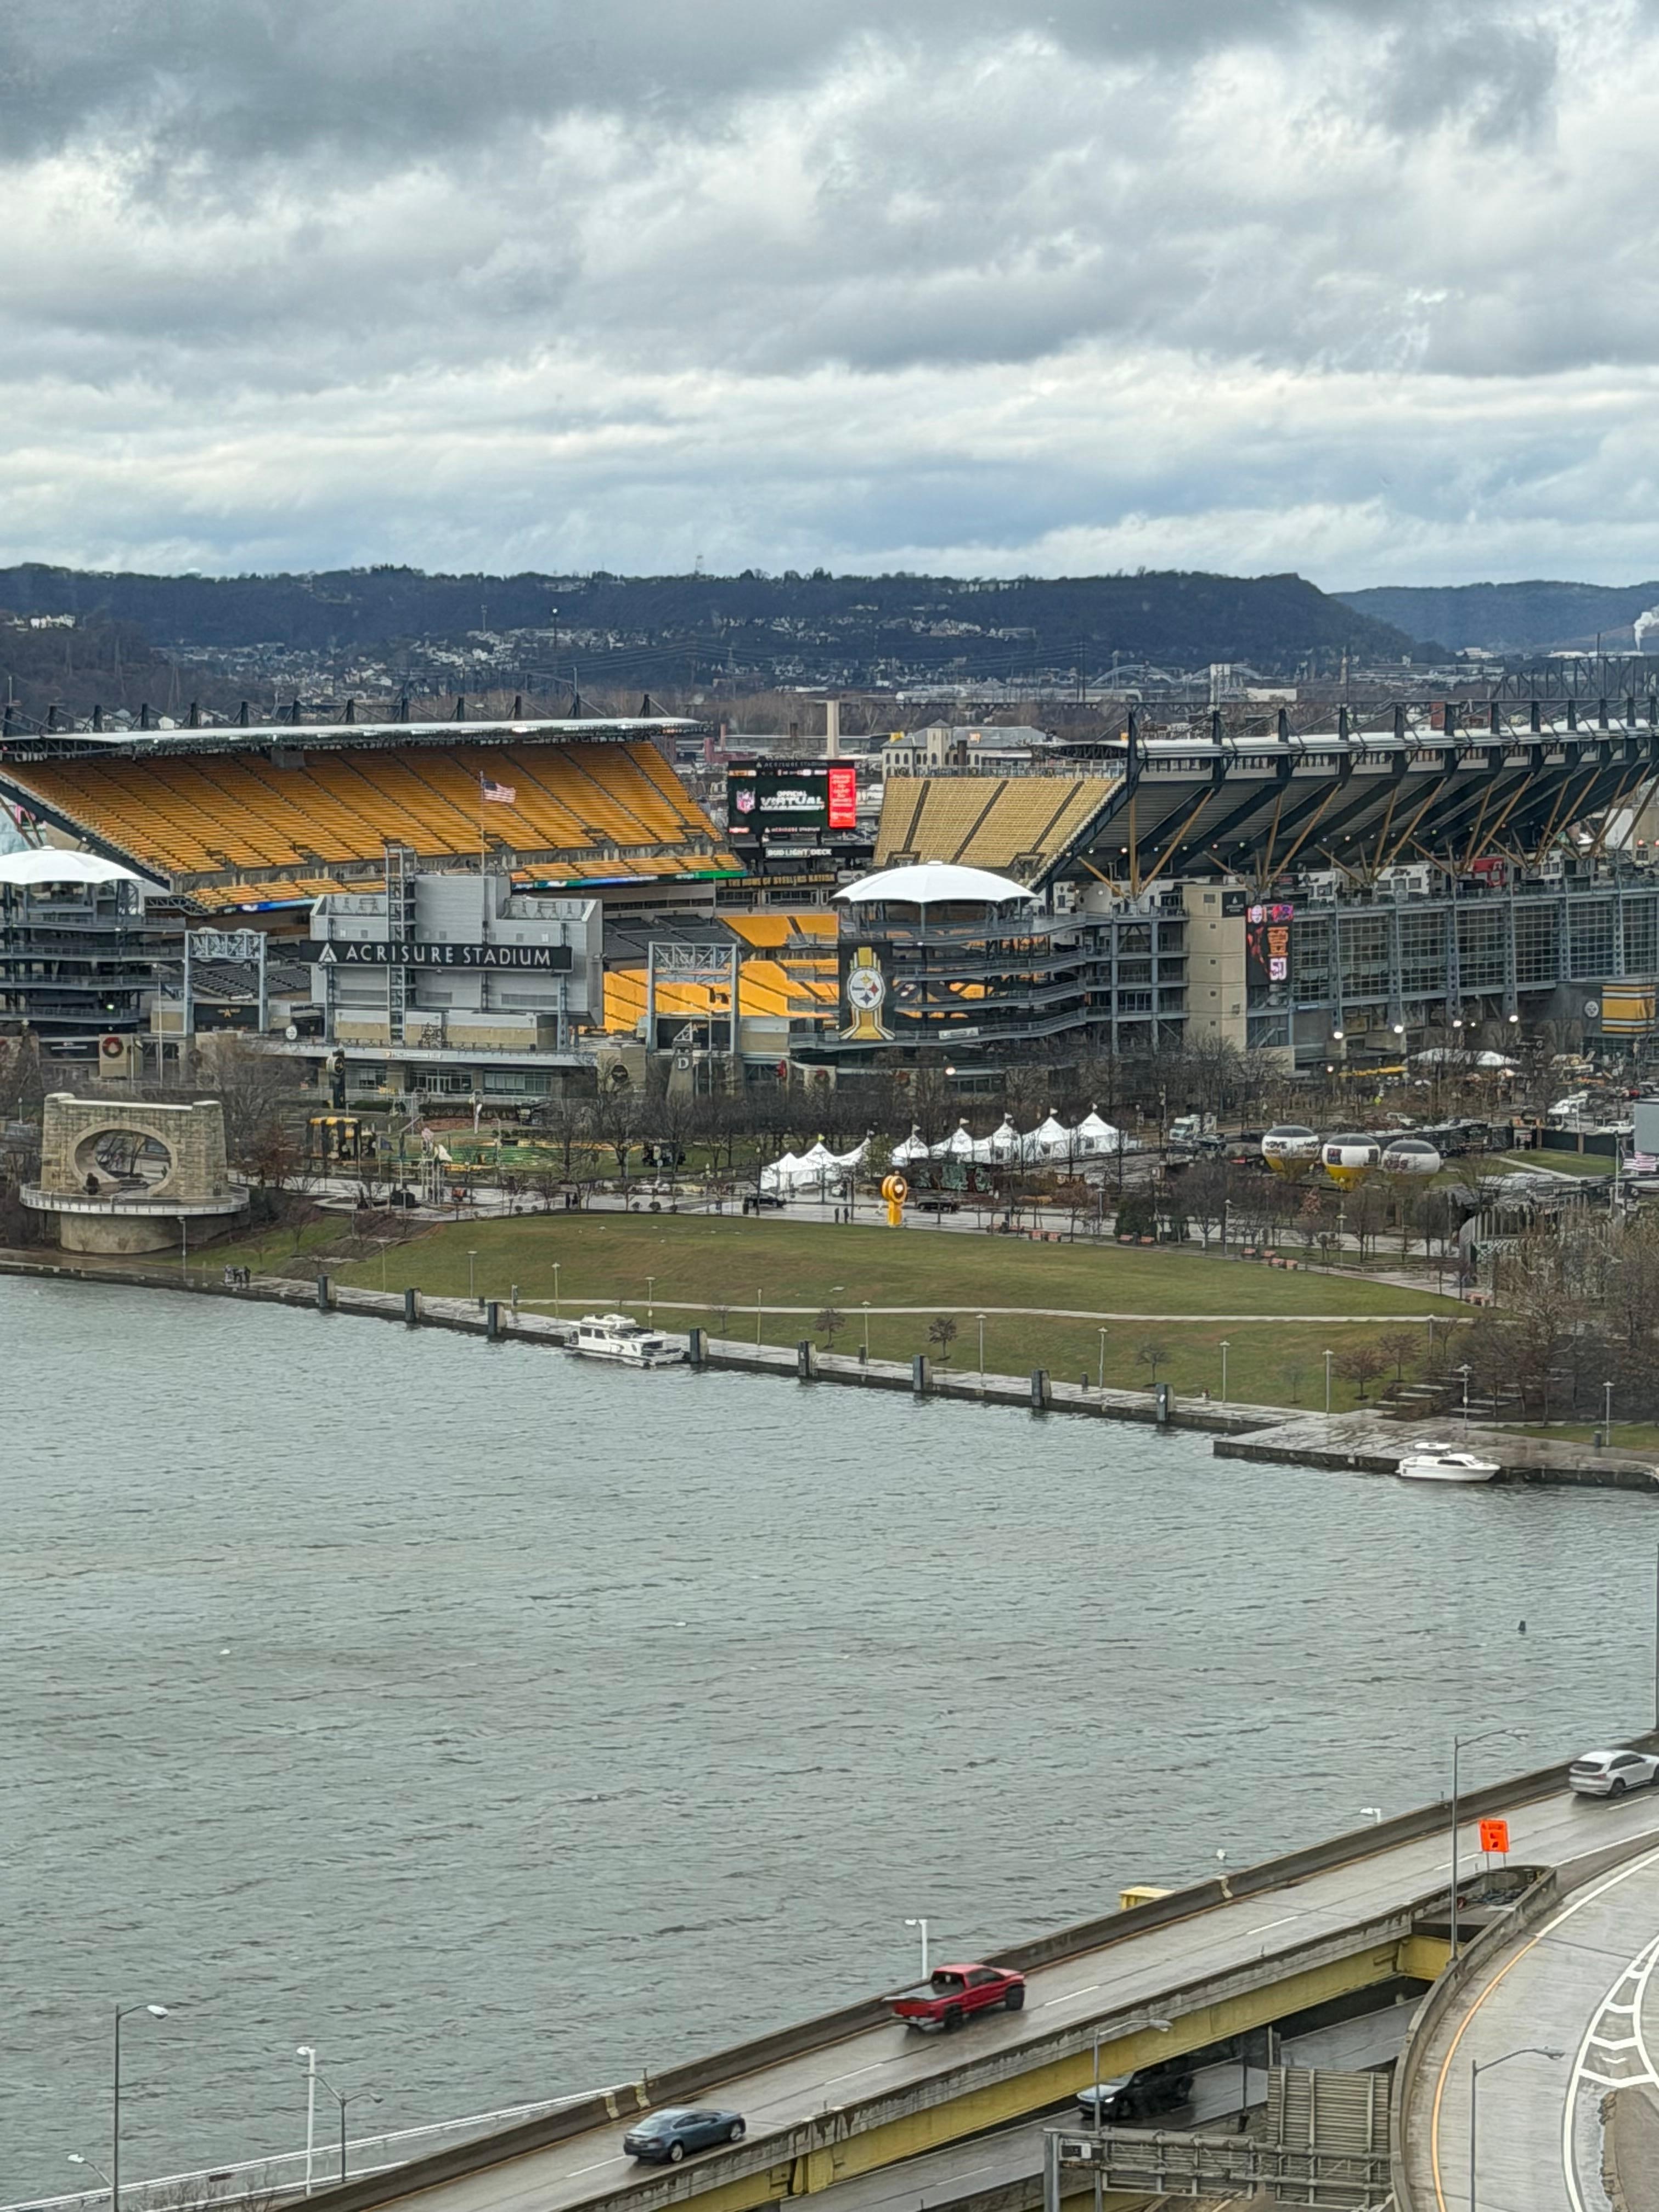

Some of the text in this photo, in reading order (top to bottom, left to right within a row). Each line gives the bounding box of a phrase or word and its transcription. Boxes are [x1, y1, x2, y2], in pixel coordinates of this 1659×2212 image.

[346, 944, 551, 966] ACRISURE STADIUM
[678, 1057, 689, 1069] D
